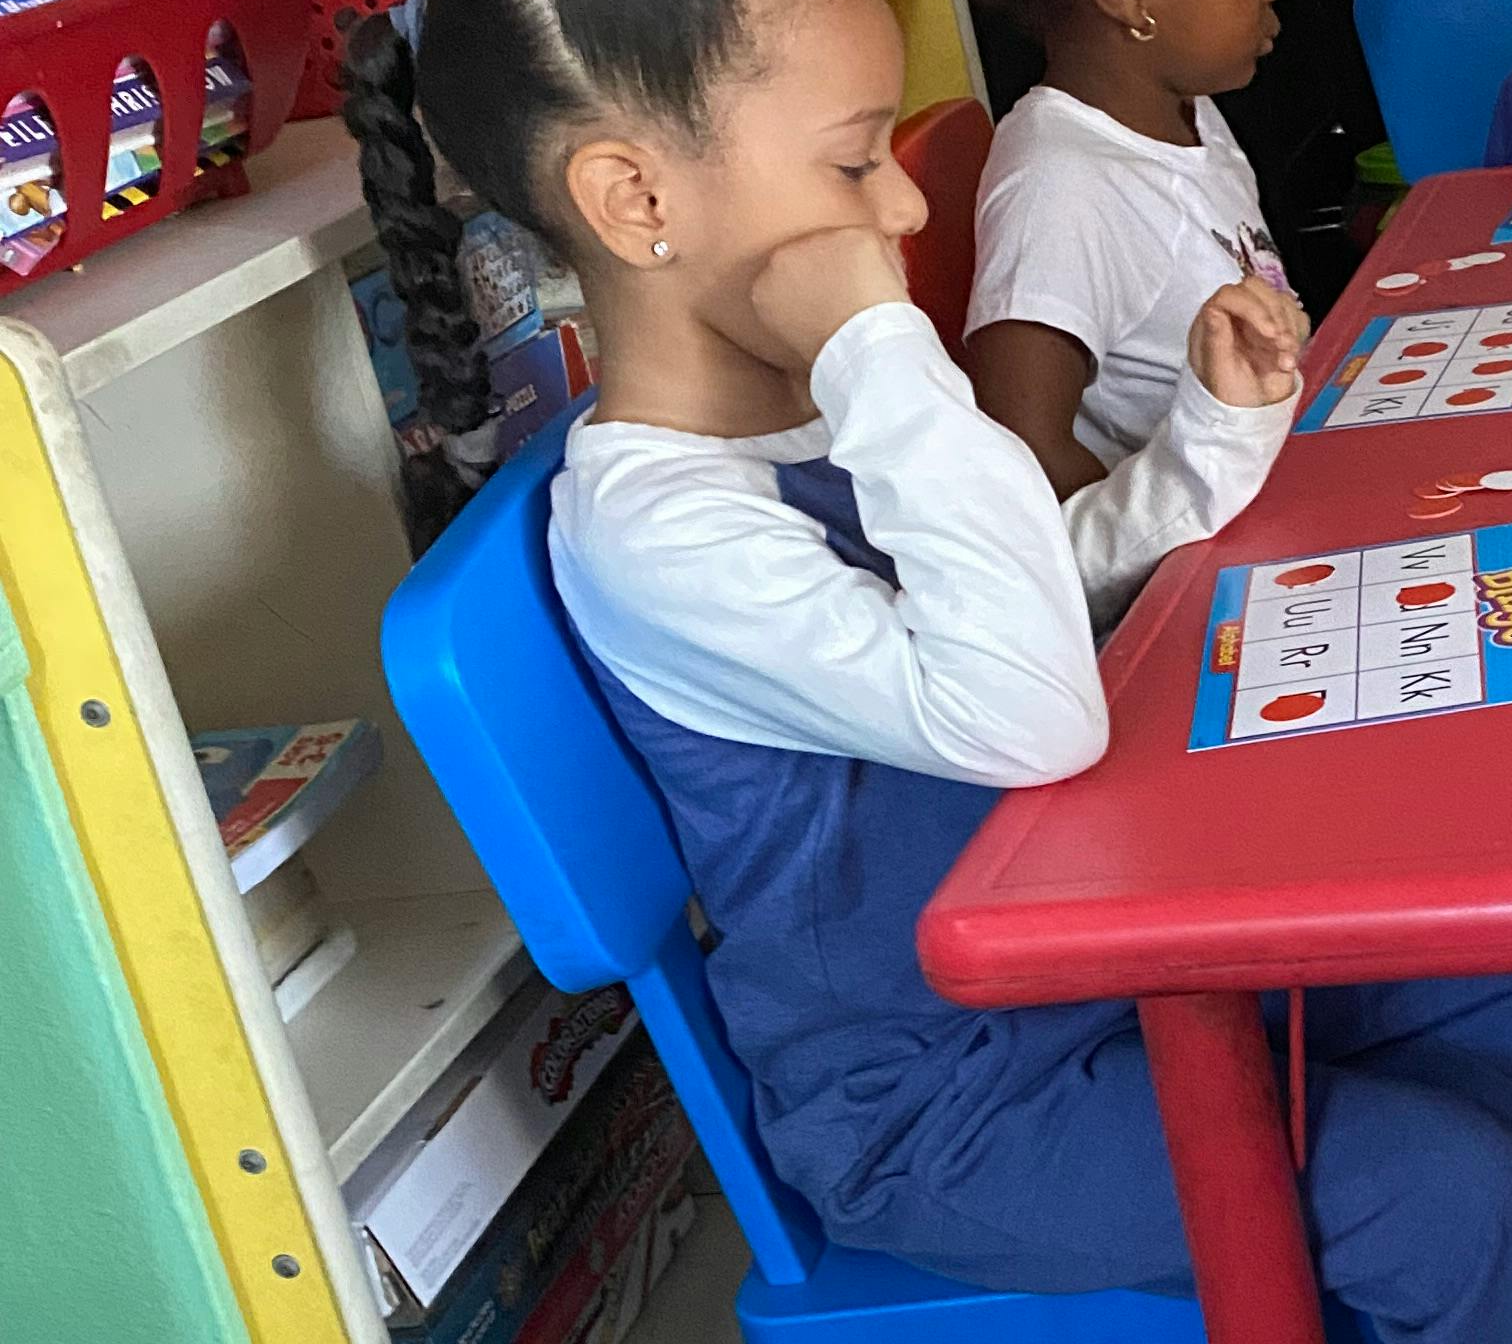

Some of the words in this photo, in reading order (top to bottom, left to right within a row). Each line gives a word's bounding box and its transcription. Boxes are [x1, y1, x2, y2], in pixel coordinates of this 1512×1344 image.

[1359, 395, 1405, 419] Kk
[1400, 544, 1447, 570] Vv
[1283, 597, 1333, 629] Uu
[1400, 622, 1450, 657] Nn
[1279, 643, 1330, 669] Rr
[1400, 669, 1452, 703] Kk
